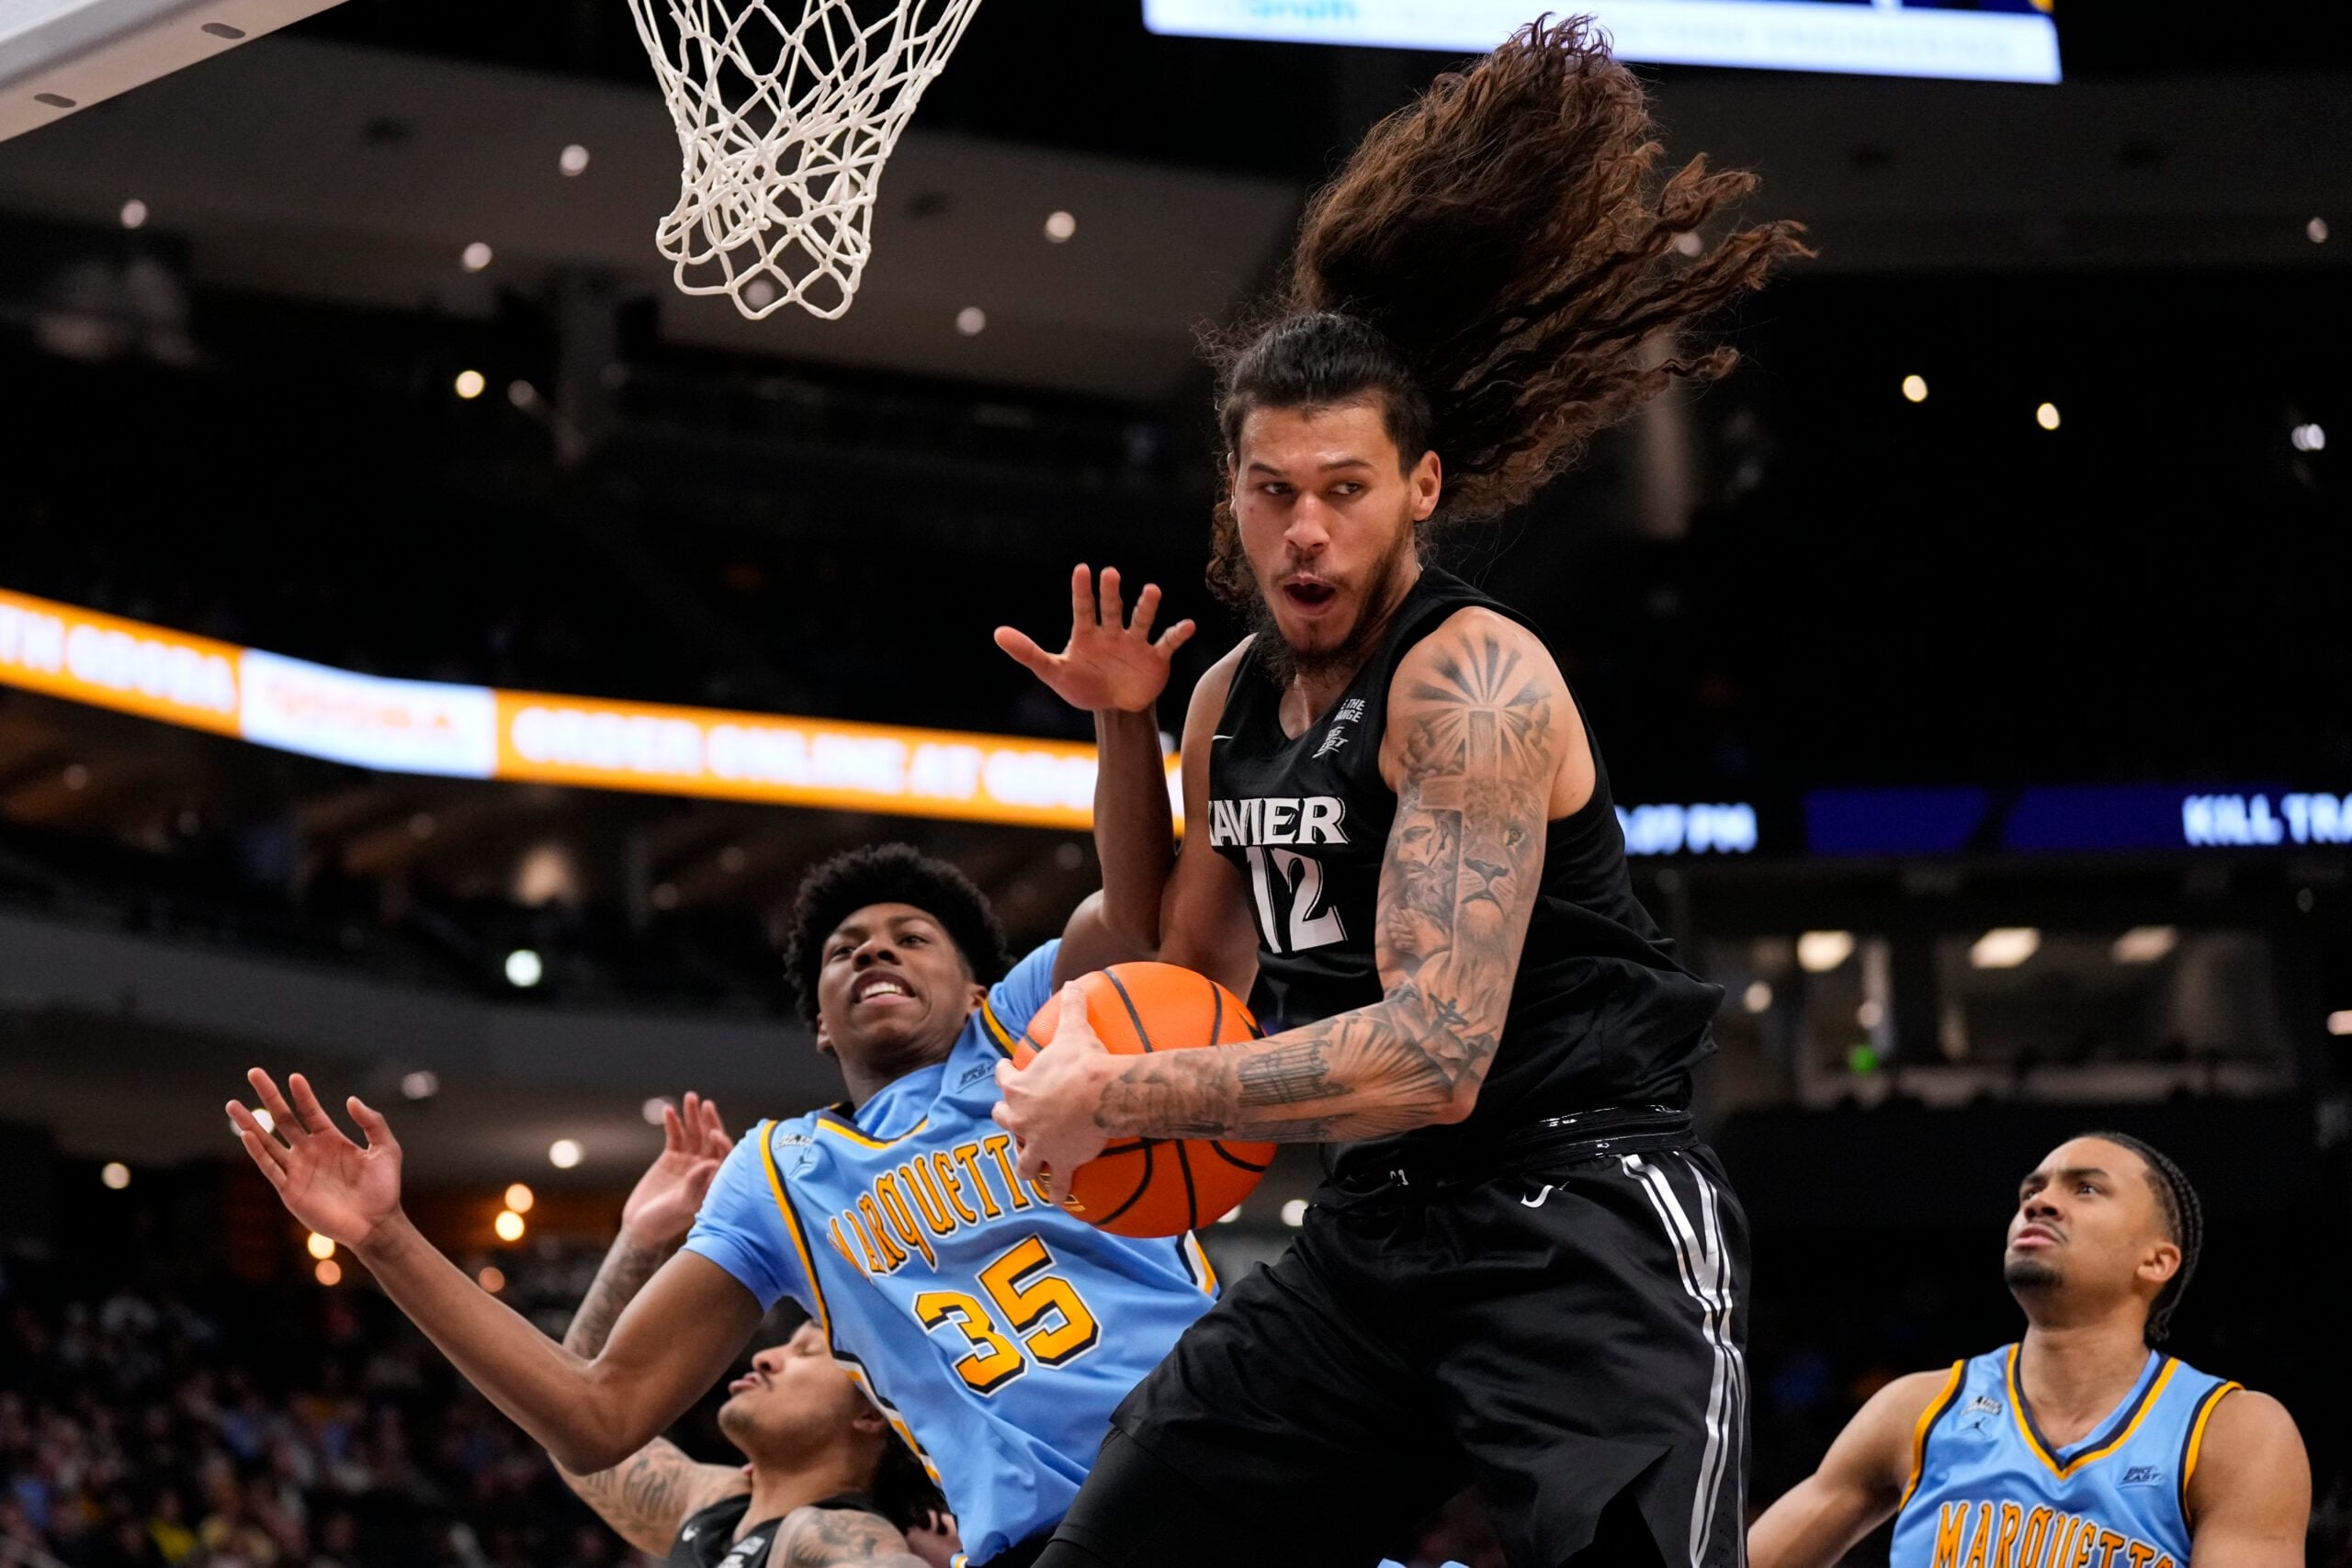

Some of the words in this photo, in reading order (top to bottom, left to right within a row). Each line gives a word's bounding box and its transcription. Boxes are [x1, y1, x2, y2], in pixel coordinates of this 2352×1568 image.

[2181, 794, 2286, 847] KILL
[1246, 846, 1349, 954] 12
[911, 1232, 1102, 1398] 35
